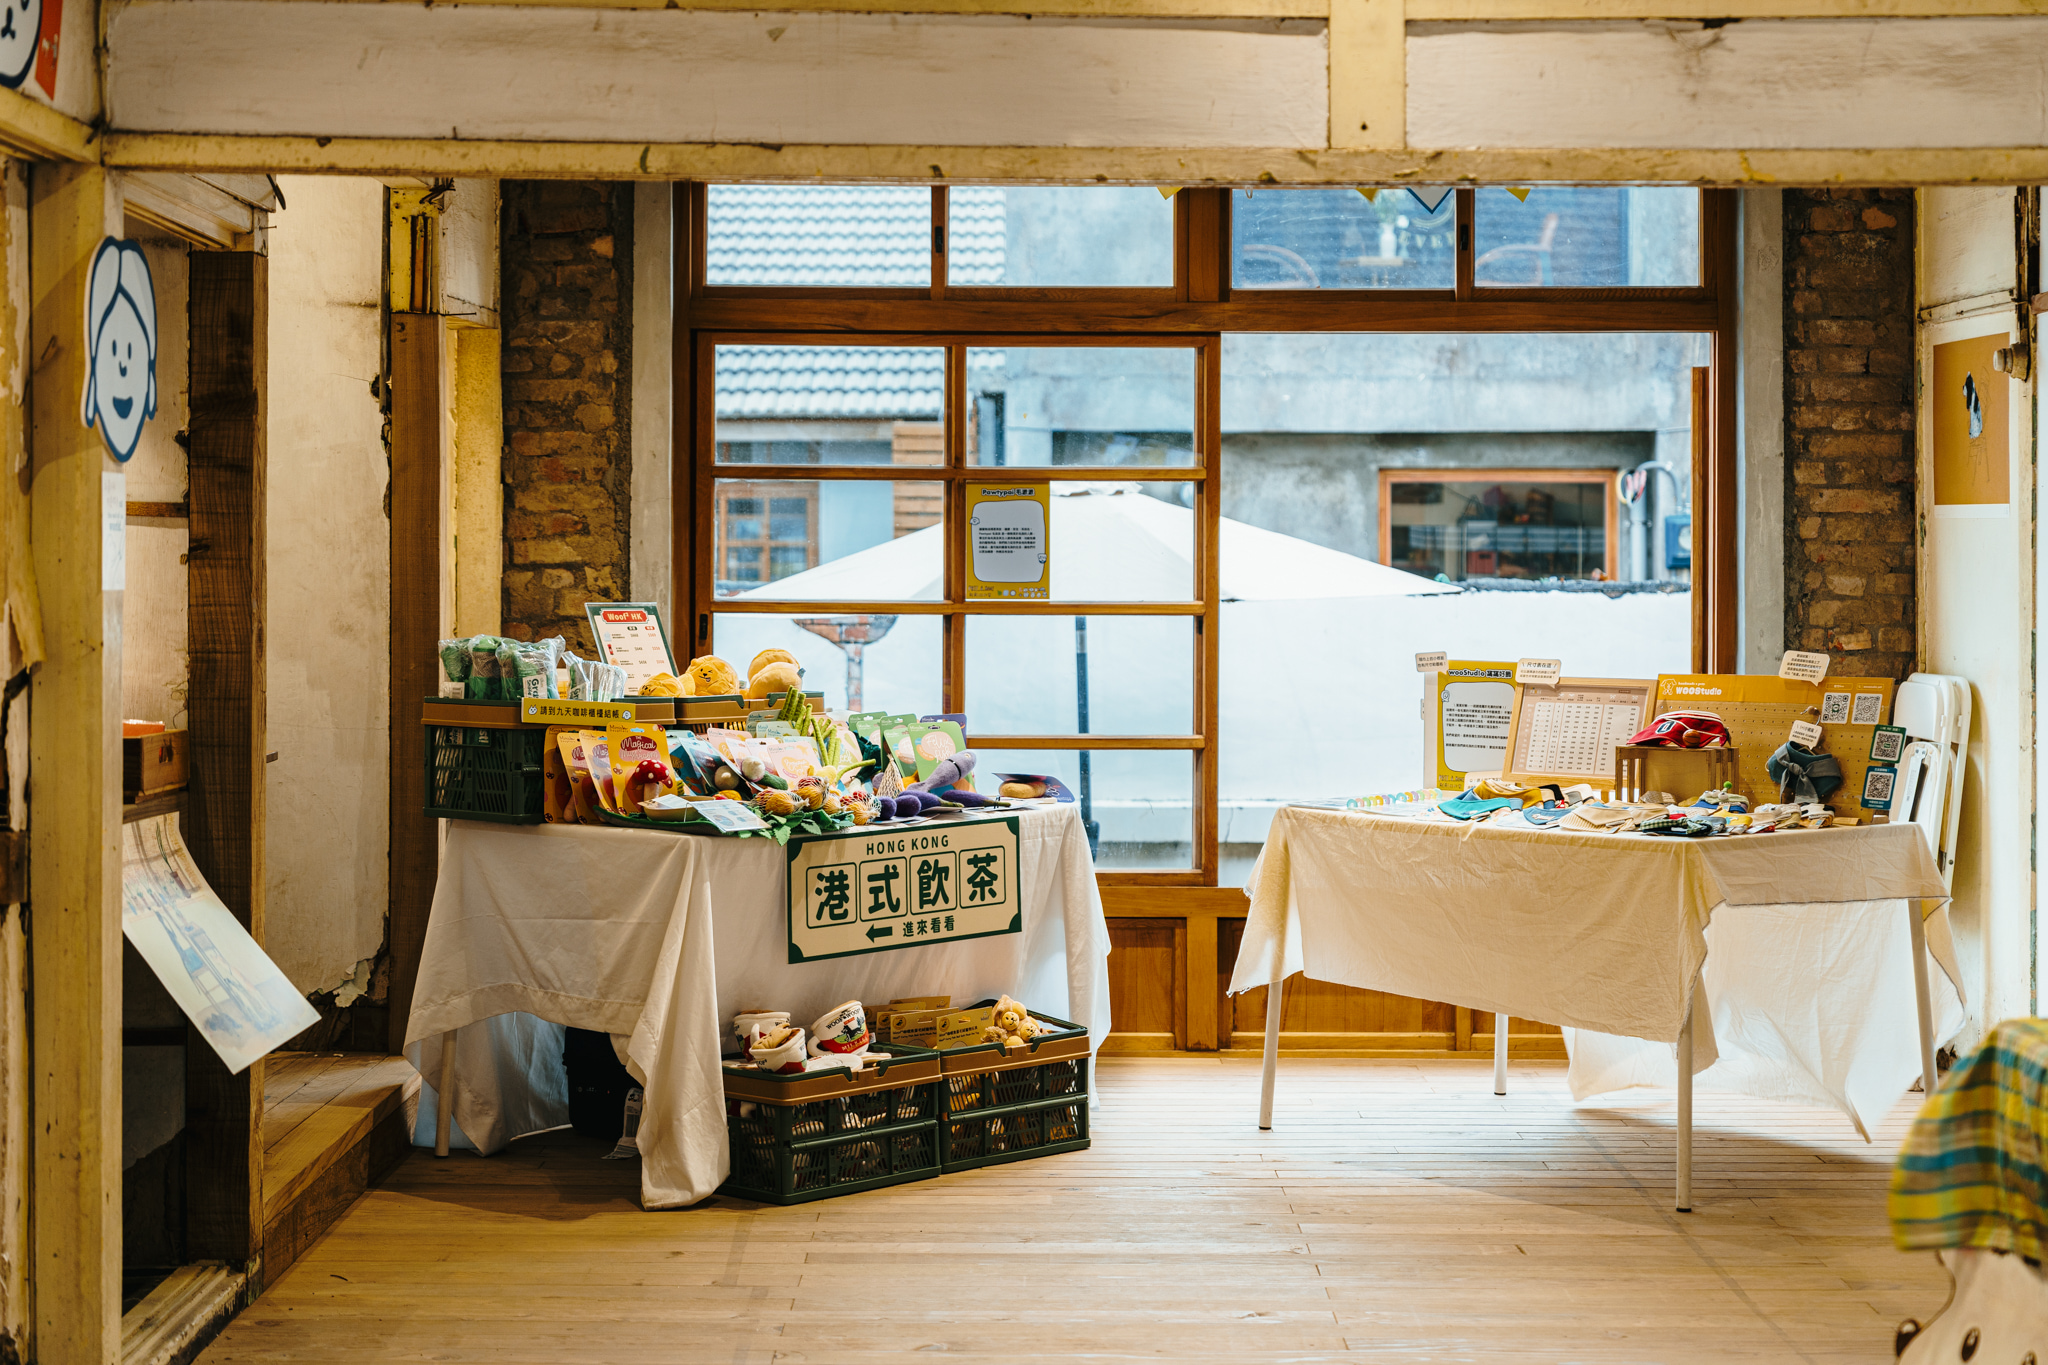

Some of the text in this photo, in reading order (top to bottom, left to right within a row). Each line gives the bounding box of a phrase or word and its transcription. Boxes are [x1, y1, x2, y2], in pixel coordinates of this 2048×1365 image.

[630, 612, 643, 620] HK
[621, 737, 656, 752] Magical
[866, 835, 949, 856] HONG KONG
[815, 852, 998, 921] 港式飲茶
[902, 915, 956, 938] 進來看看
